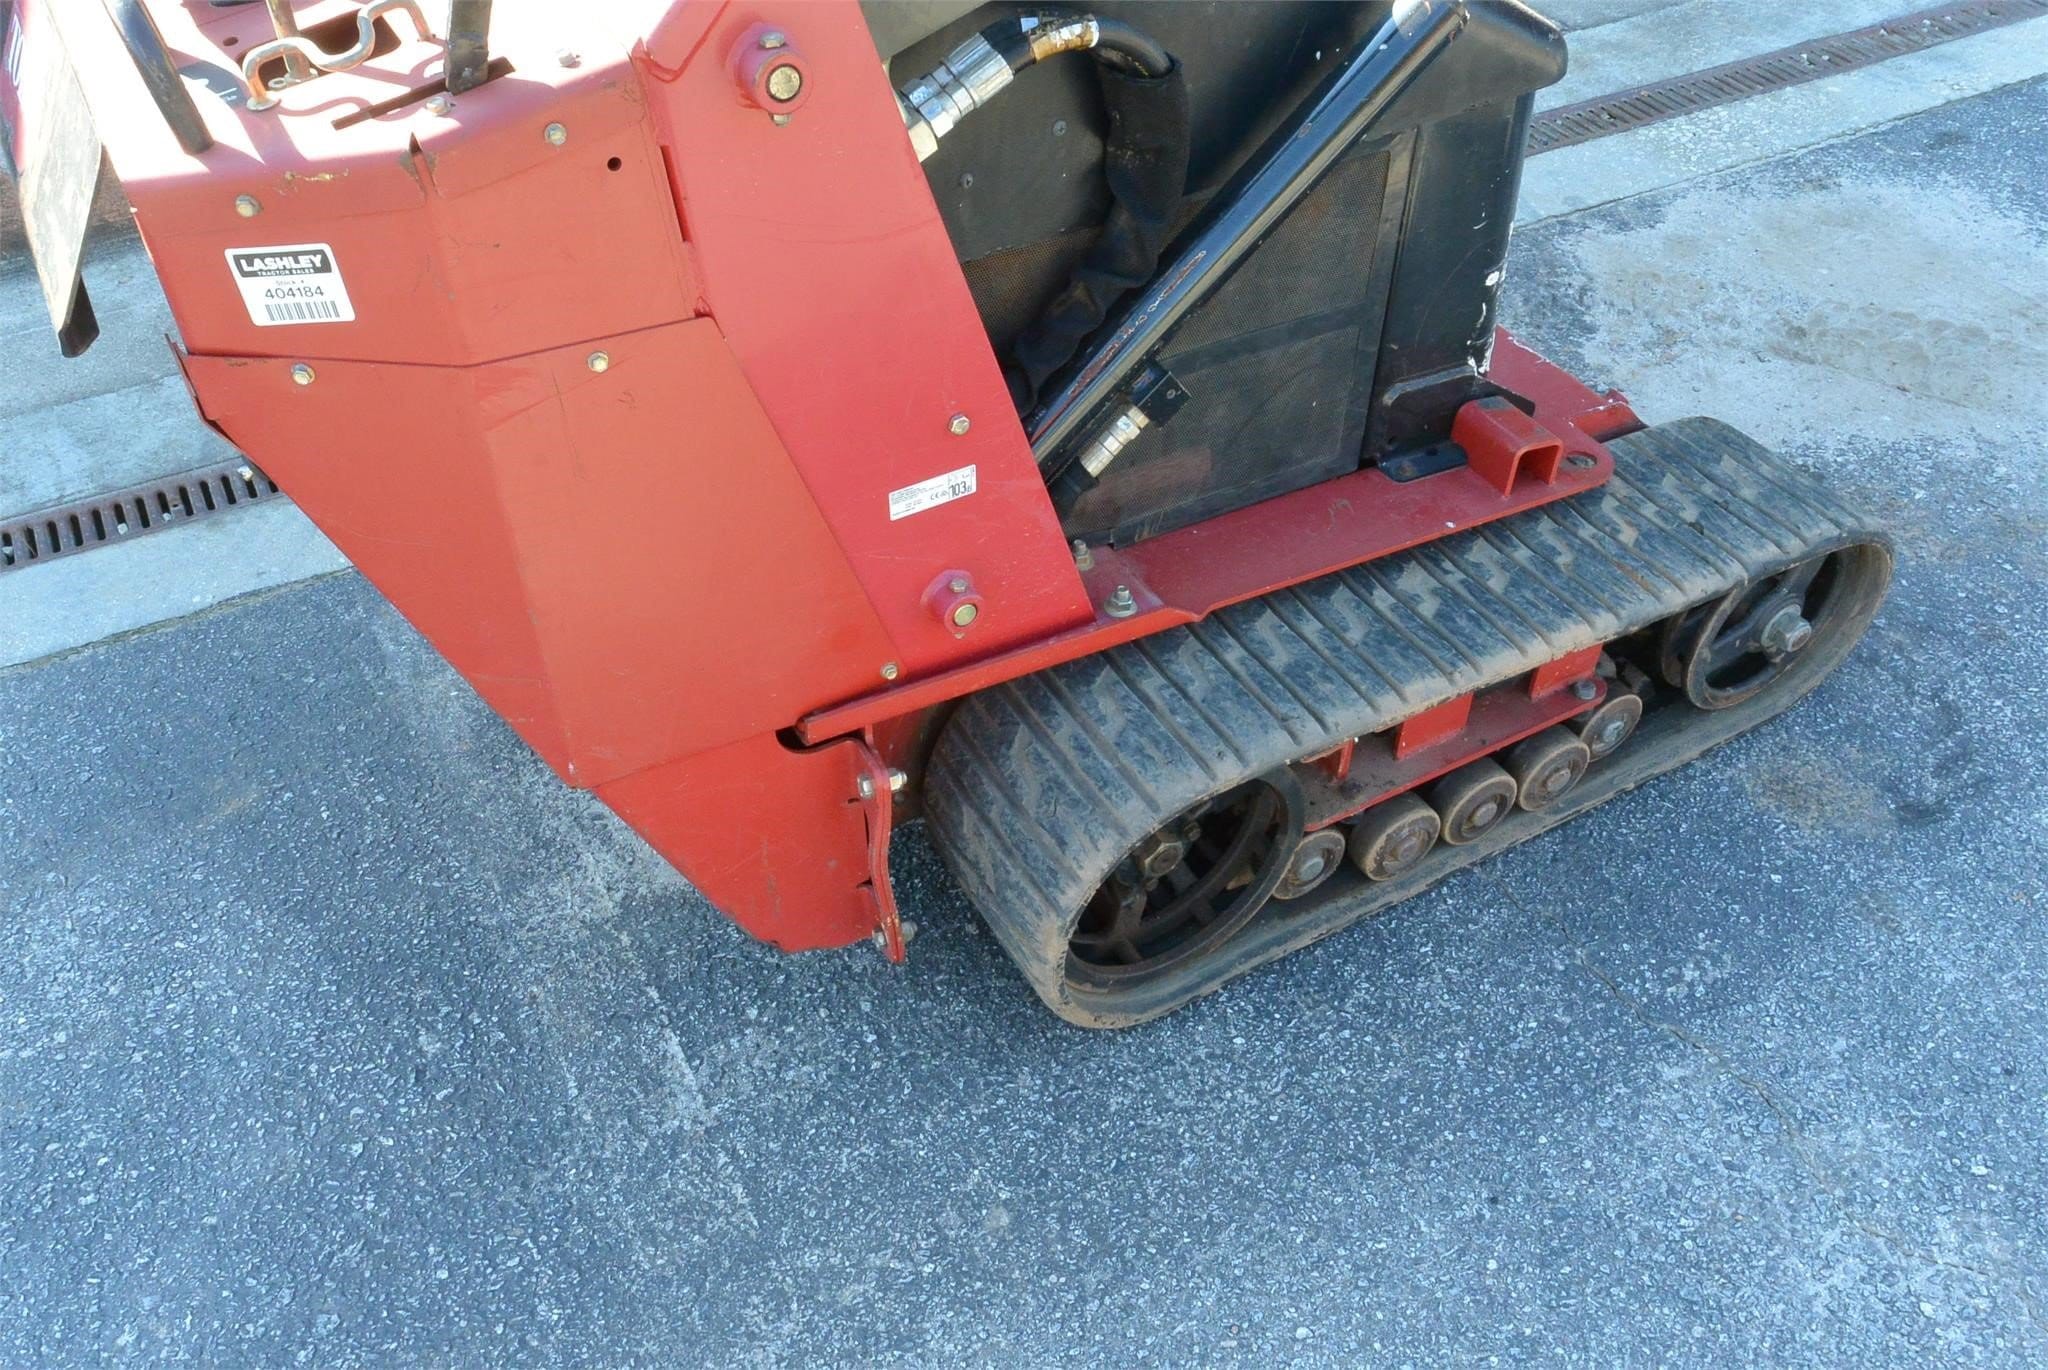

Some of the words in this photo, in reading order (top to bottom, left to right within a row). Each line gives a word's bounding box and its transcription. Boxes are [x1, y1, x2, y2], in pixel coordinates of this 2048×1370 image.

[240, 254, 322, 271] LASHLEY
[257, 269, 290, 277] TRACTOR
[265, 286, 324, 299] 404184
[949, 481, 967, 498] 103
